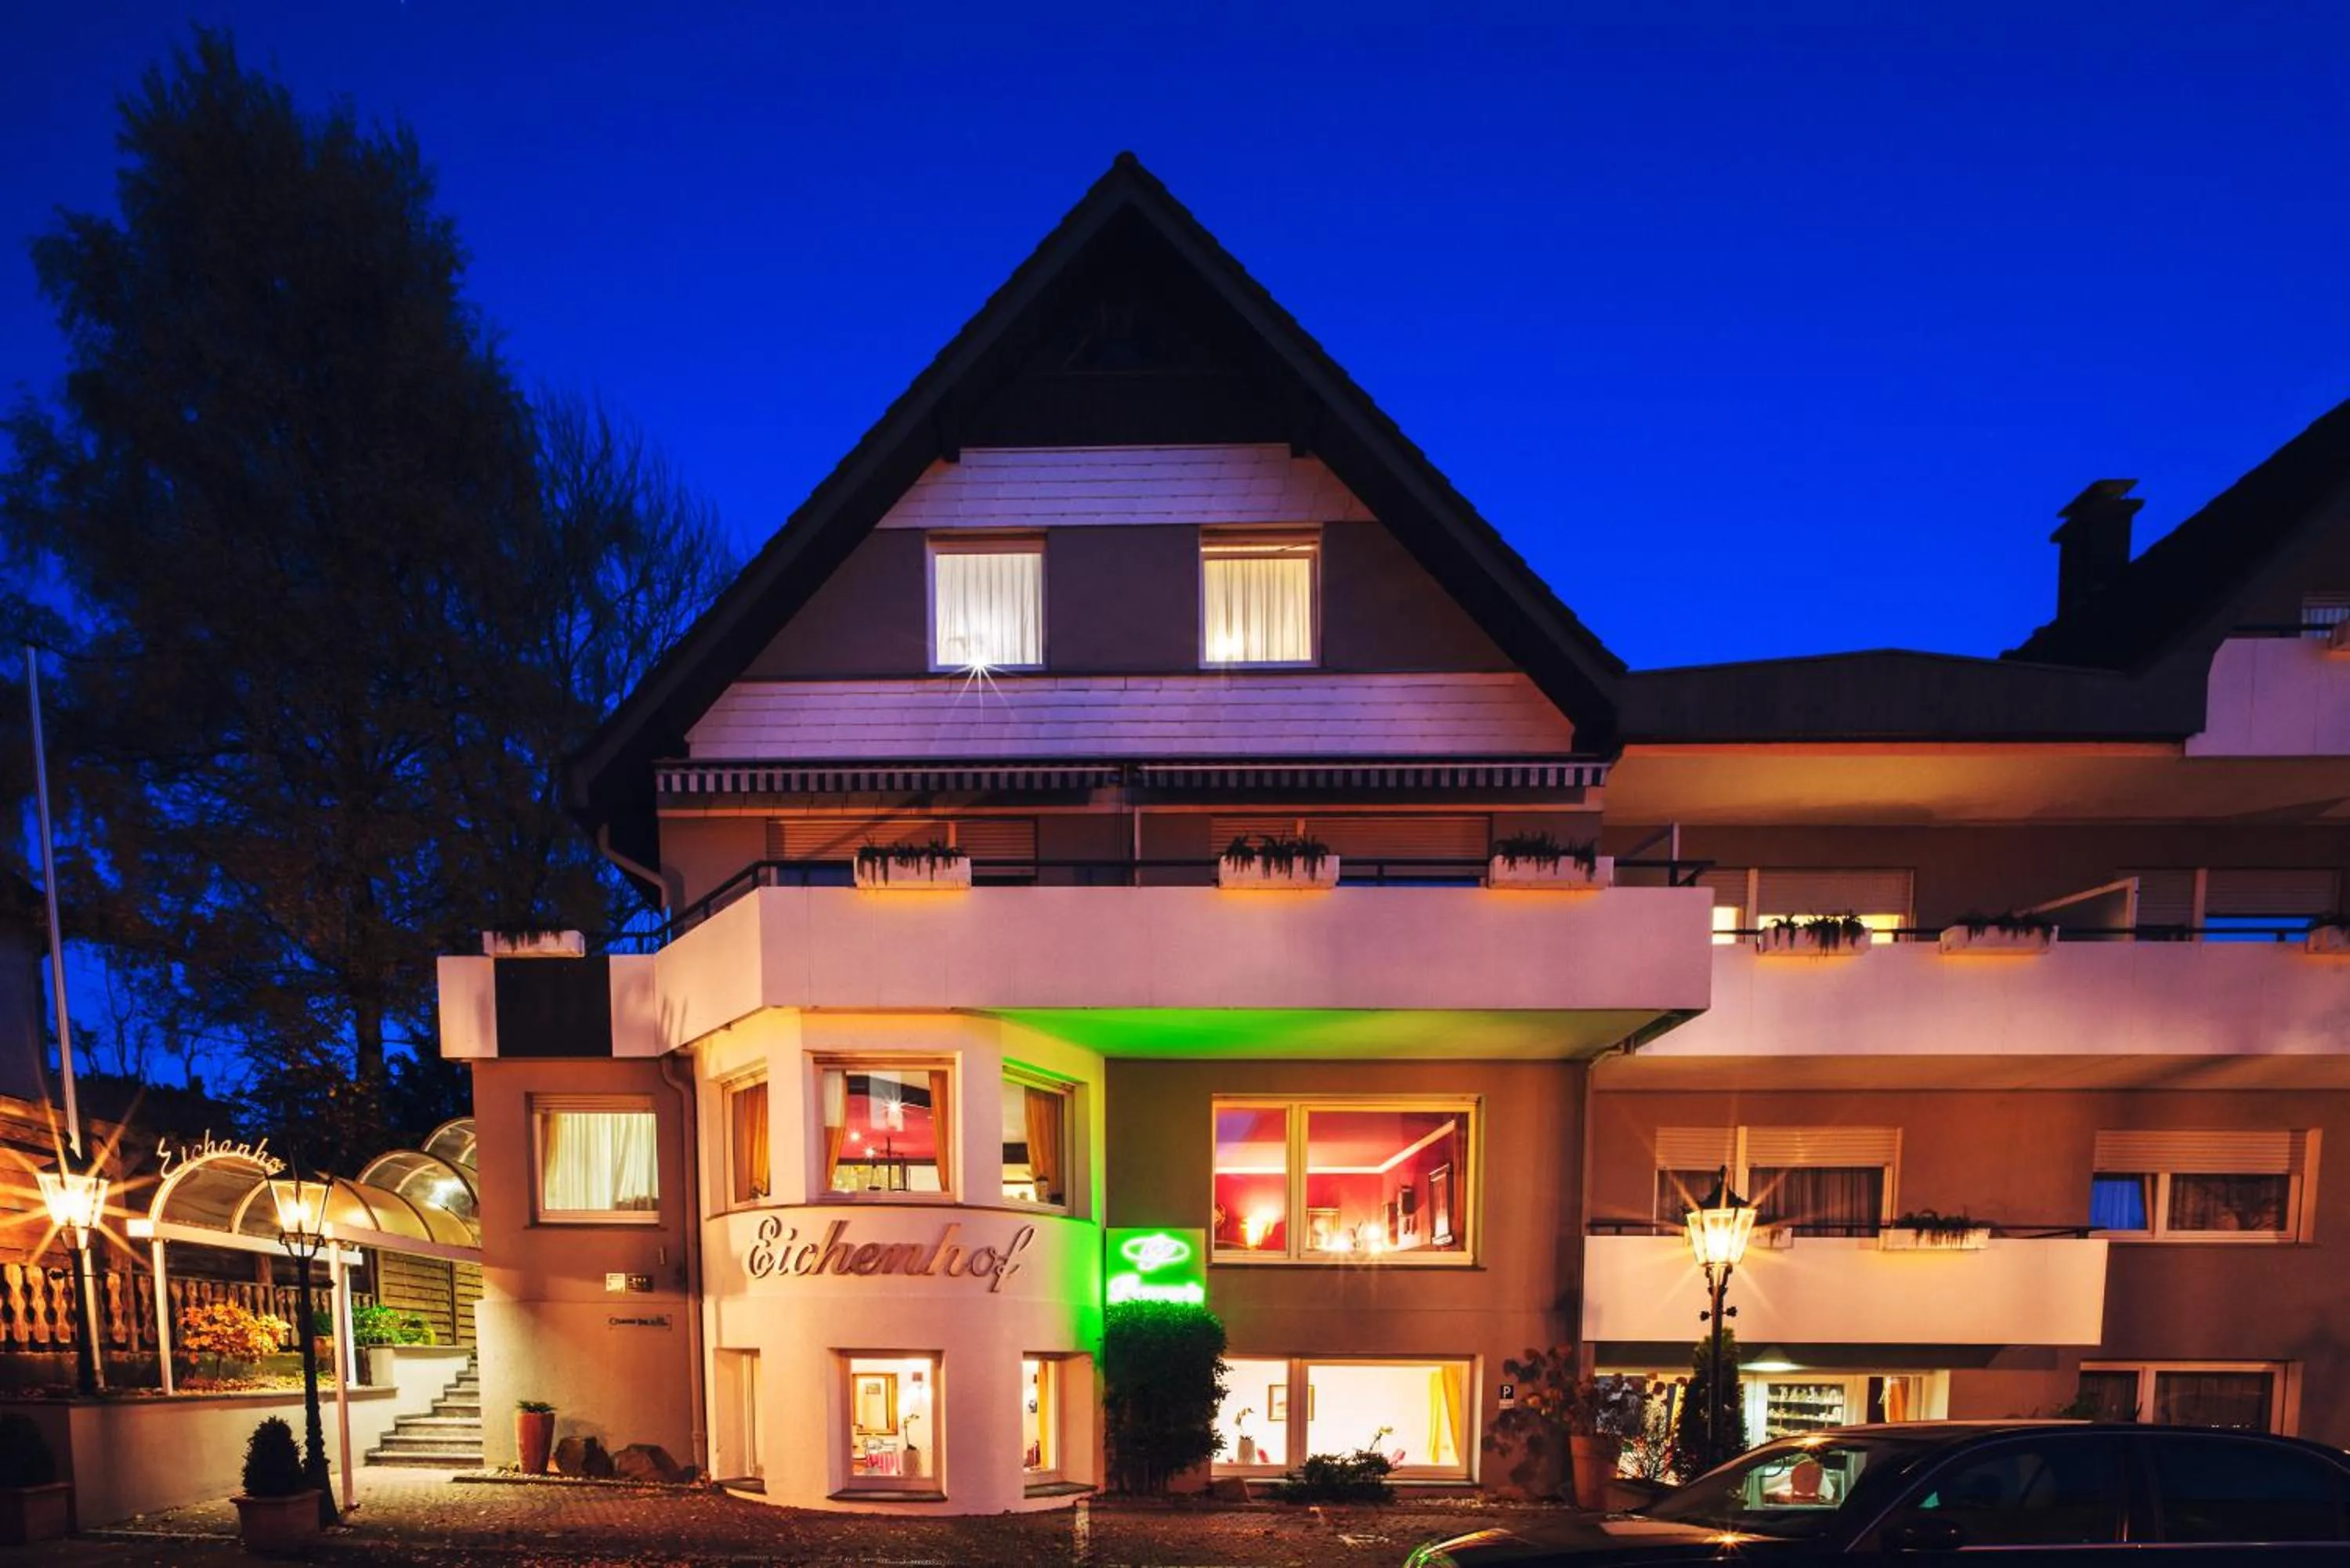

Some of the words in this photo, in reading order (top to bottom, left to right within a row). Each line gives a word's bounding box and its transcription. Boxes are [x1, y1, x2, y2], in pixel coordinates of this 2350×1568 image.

[157, 1128, 287, 1178] Eichenho
[747, 1215, 1036, 1293] Eichenhof
[1503, 1386, 1511, 1398] P
